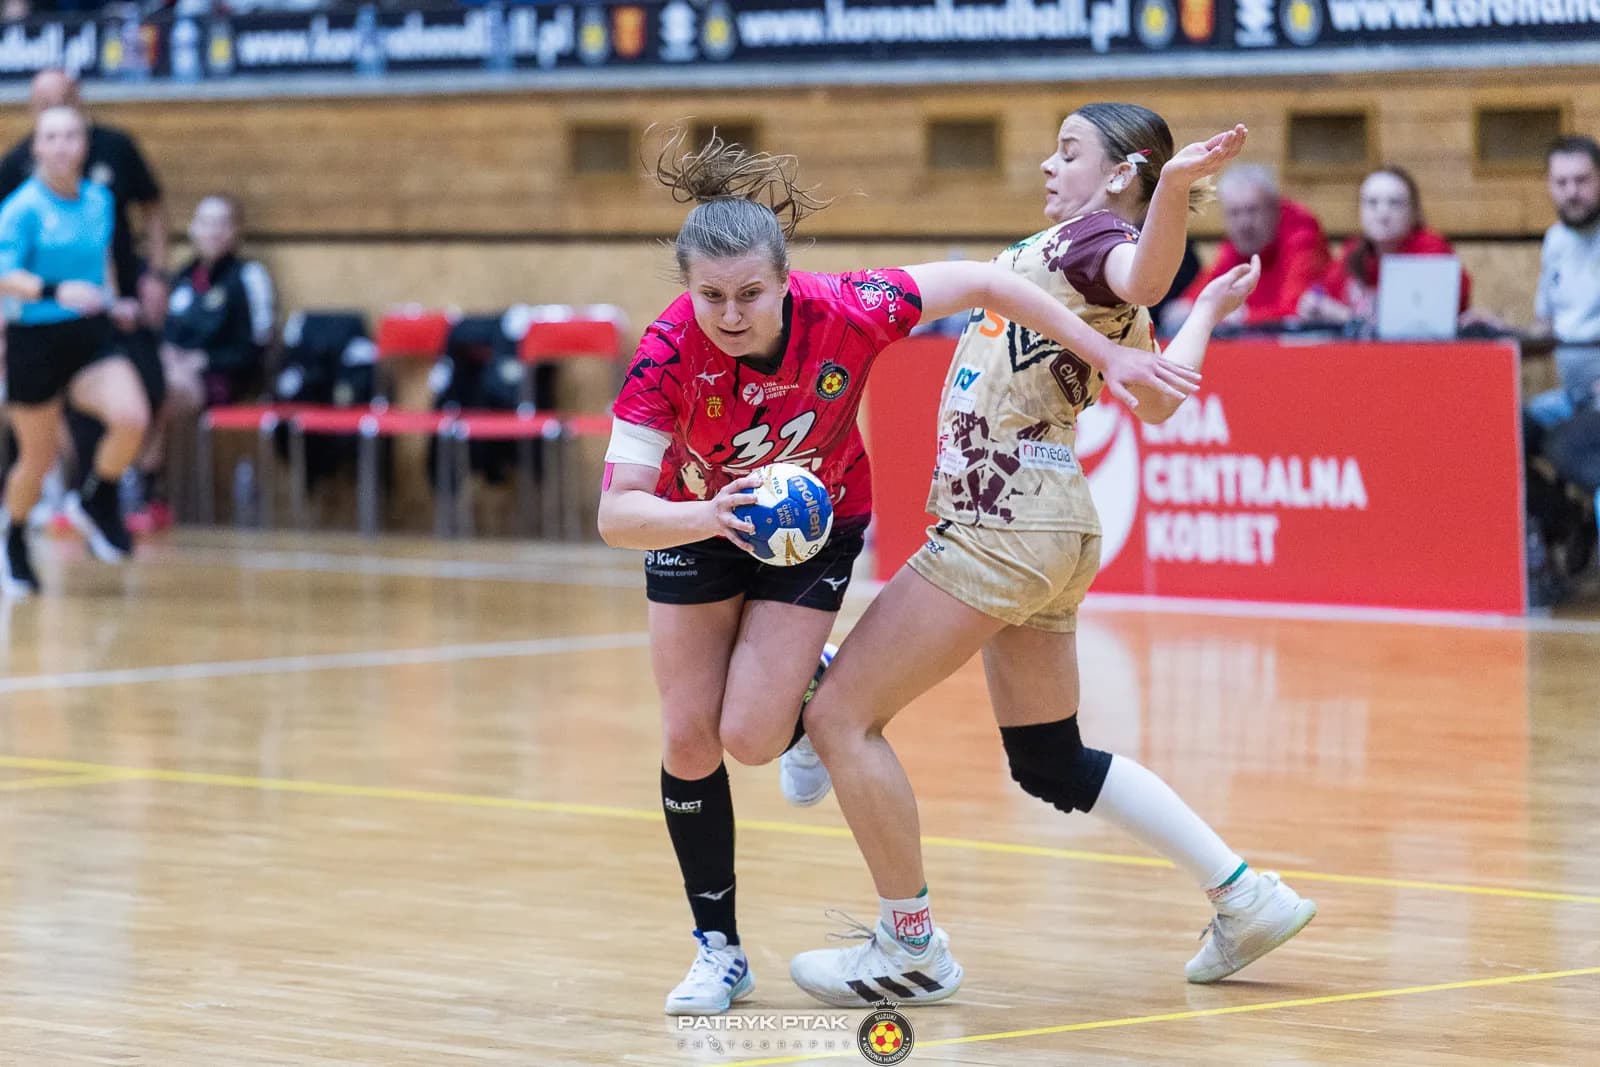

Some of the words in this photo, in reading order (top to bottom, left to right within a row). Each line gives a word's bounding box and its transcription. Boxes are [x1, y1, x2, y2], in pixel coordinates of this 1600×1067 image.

[736, 0, 1131, 53] www.koronahandball.pl
[726, 410, 818, 468] 32
[1143, 453, 1367, 510] CENTRALNA
[1145, 512, 1279, 566] KOBIET
